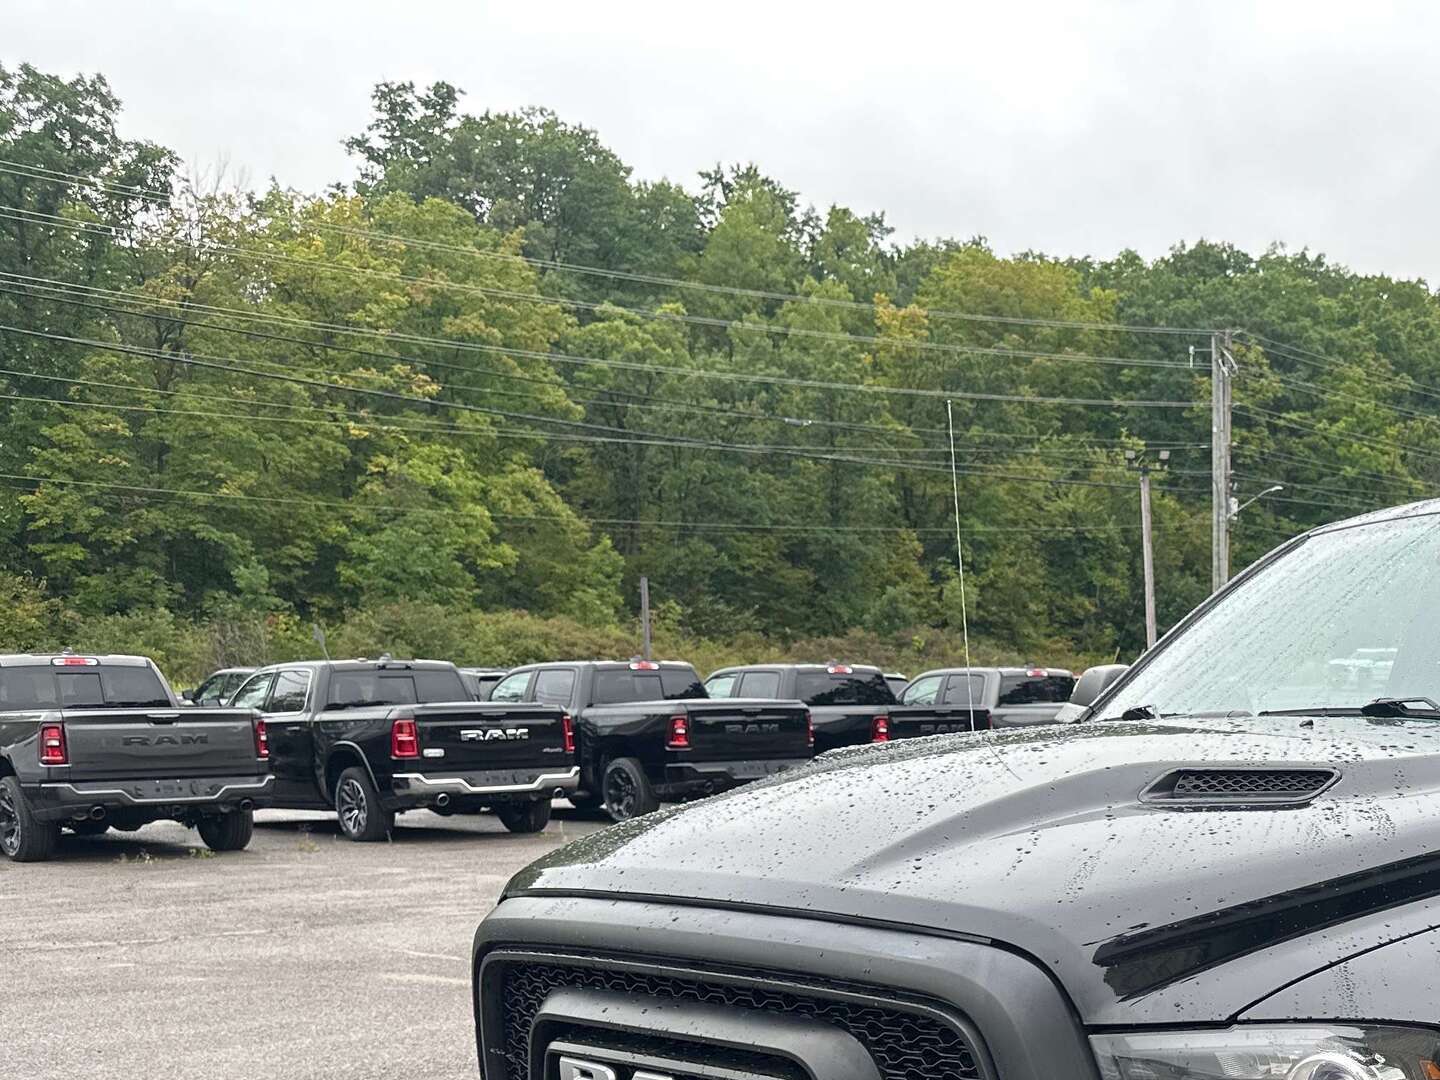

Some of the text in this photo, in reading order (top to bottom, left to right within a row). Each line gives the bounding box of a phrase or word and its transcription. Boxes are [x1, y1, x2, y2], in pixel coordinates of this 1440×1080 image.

[460, 729, 530, 742] RAM
[726, 724, 780, 735] RAM
[123, 734, 209, 746] RAM
